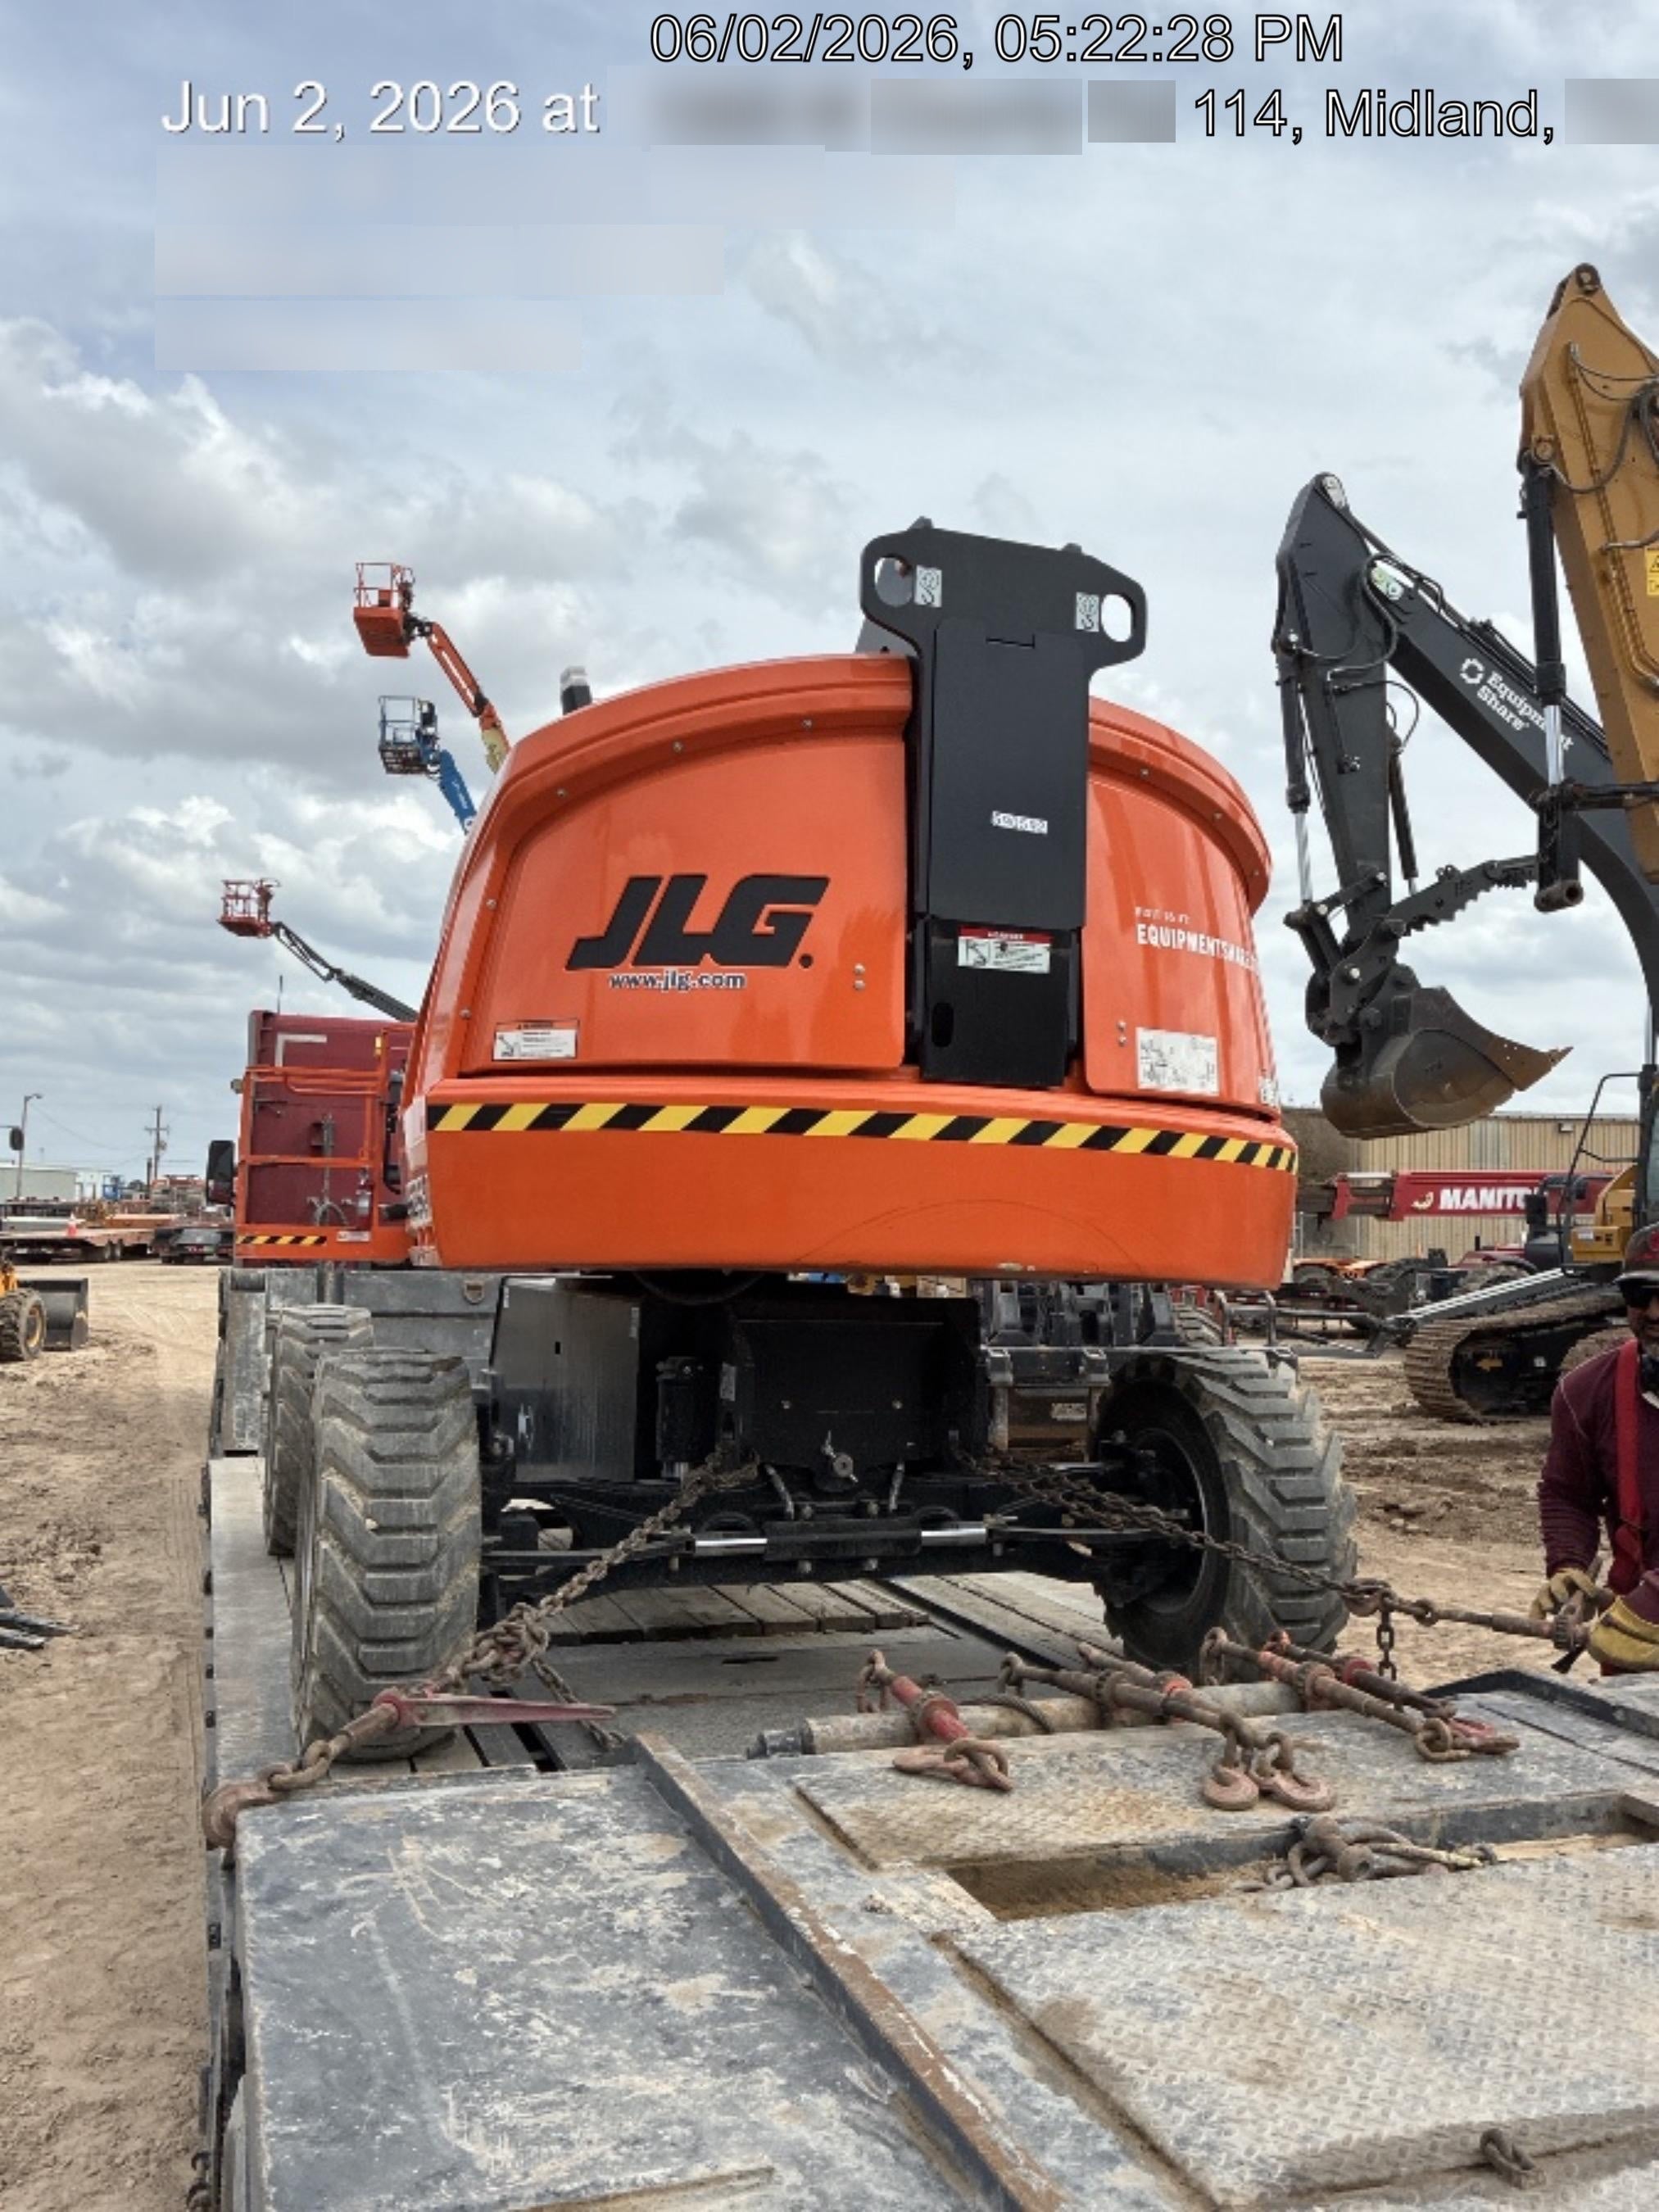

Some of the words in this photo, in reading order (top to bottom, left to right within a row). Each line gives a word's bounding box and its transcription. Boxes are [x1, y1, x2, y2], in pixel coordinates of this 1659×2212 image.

[1476, 685, 1525, 731] Share
[1487, 671, 1574, 751] Equipmt
[610, 969, 746, 991] www.jlg.com
[1439, 1187, 1547, 1211] MANITO
